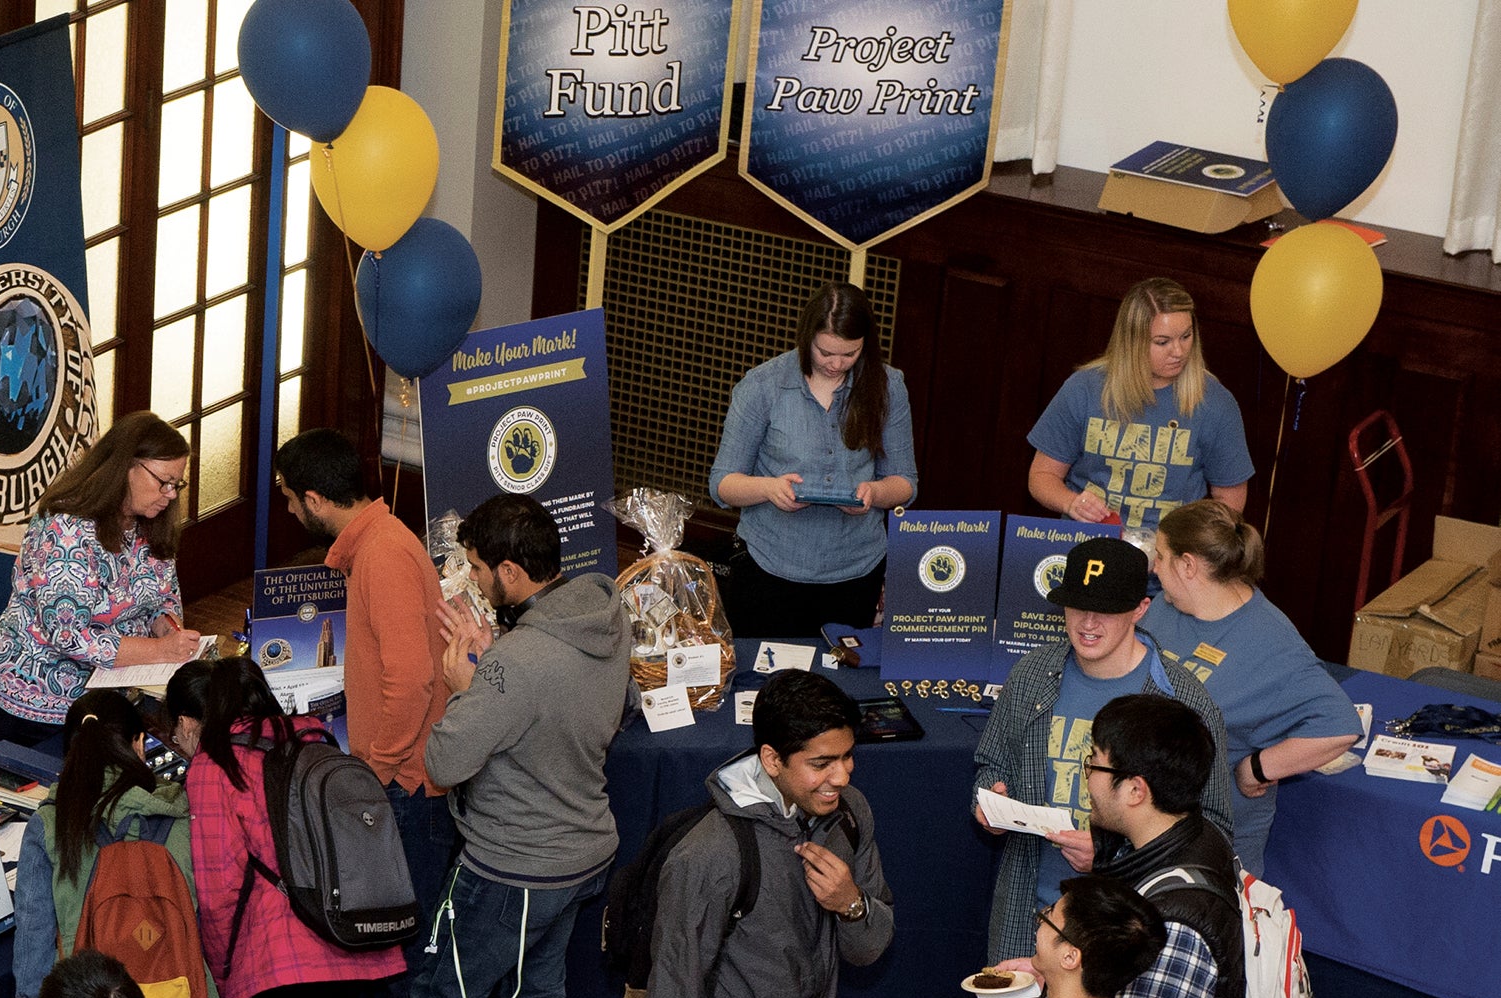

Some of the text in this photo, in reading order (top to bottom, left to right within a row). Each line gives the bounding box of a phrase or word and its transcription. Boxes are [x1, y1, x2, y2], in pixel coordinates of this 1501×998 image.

[570, 4, 669, 56] Pitt
[802, 25, 955, 72] Project
[543, 60, 684, 119] Fund
[766, 76, 982, 115] Paw Print
[3, 94, 18, 111] OF
[452, 328, 578, 372] Make Your Mark!
[65, 350, 83, 401] OF
[465, 367, 568, 396] #PROJECTPAWPRINT
[491, 413, 516, 448] PROJECT
[534, 415, 552, 435] PRINT
[1084, 416, 1194, 466] HAIL
[493, 455, 552, 491] PITT SENIOR CLASS GIFT
[1105, 458, 1168, 498] TO
[557, 501, 595, 513] FUNDRAISING
[899, 520, 990, 534] Make Your Mark!
[1016, 526, 1074, 543] Make Your
[560, 553, 577, 562] RAME
[264, 575, 283, 586] THE
[285, 571, 328, 584] OFFICIAL
[1083, 559, 1105, 586] P
[263, 579, 347, 596] OF THE UNIVERSIT
[271, 589, 345, 605] OF PITTSBURGH
[892, 615, 986, 623] PROJECT PAW PRINT
[1021, 611, 1065, 623] SAVE 20%
[890, 625, 987, 633] COMMENCEMENT PIN
[1013, 621, 1056, 632] DIPLOMA
[354, 916, 416, 934] TIMBERLAND
